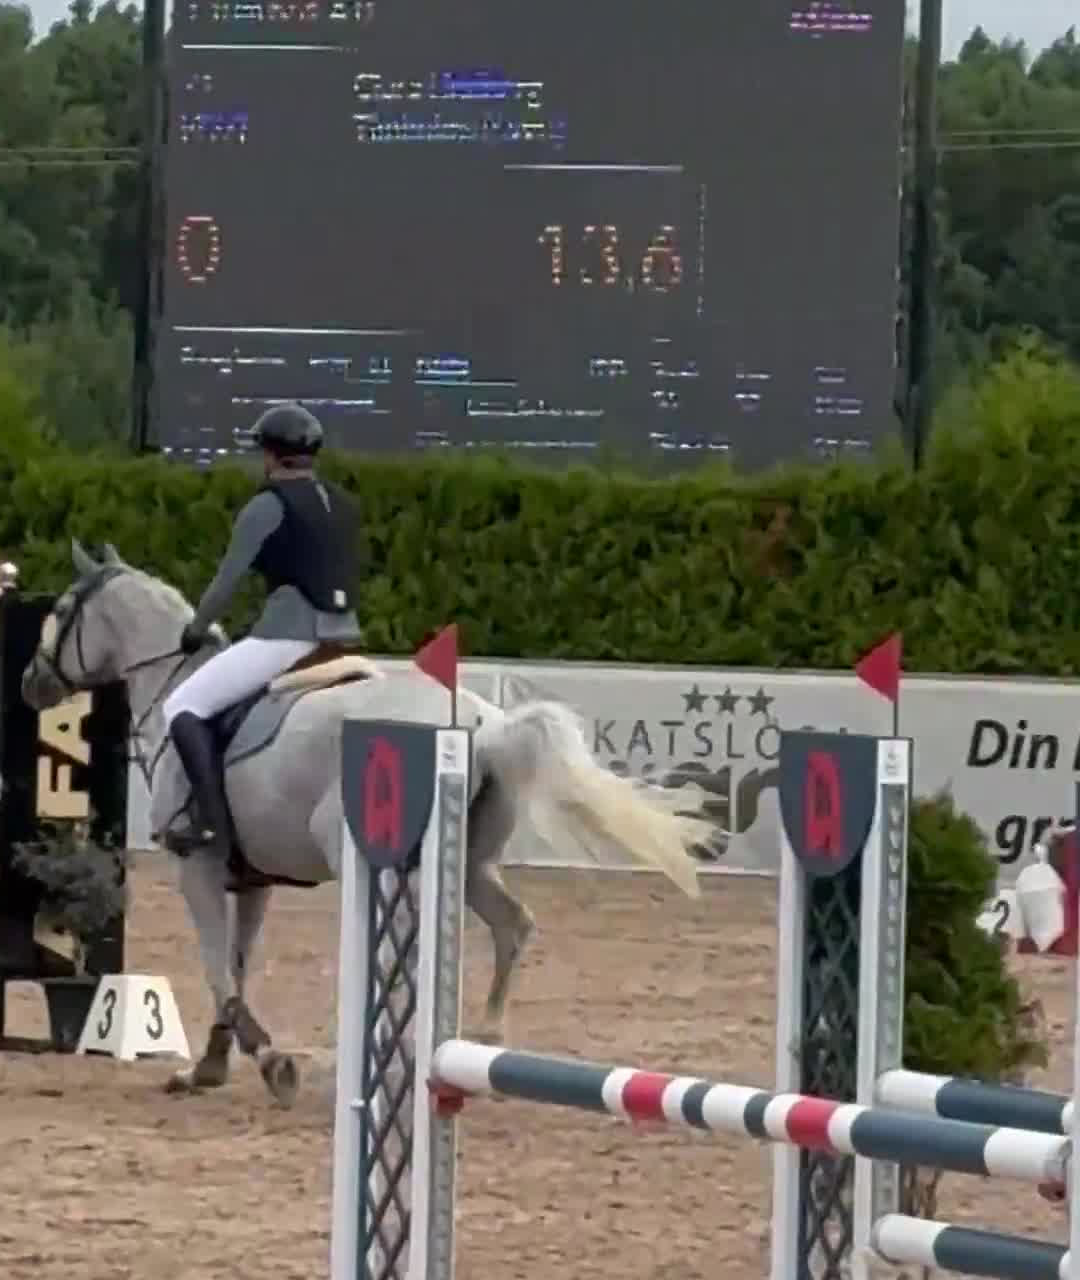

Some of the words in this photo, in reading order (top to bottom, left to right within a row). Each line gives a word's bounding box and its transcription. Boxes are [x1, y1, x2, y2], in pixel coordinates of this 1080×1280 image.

[177, 215, 221, 284] 0
[967, 719, 1060, 770] Din
[98, 988, 117, 1040] 3
[143, 988, 164, 1041] 3
